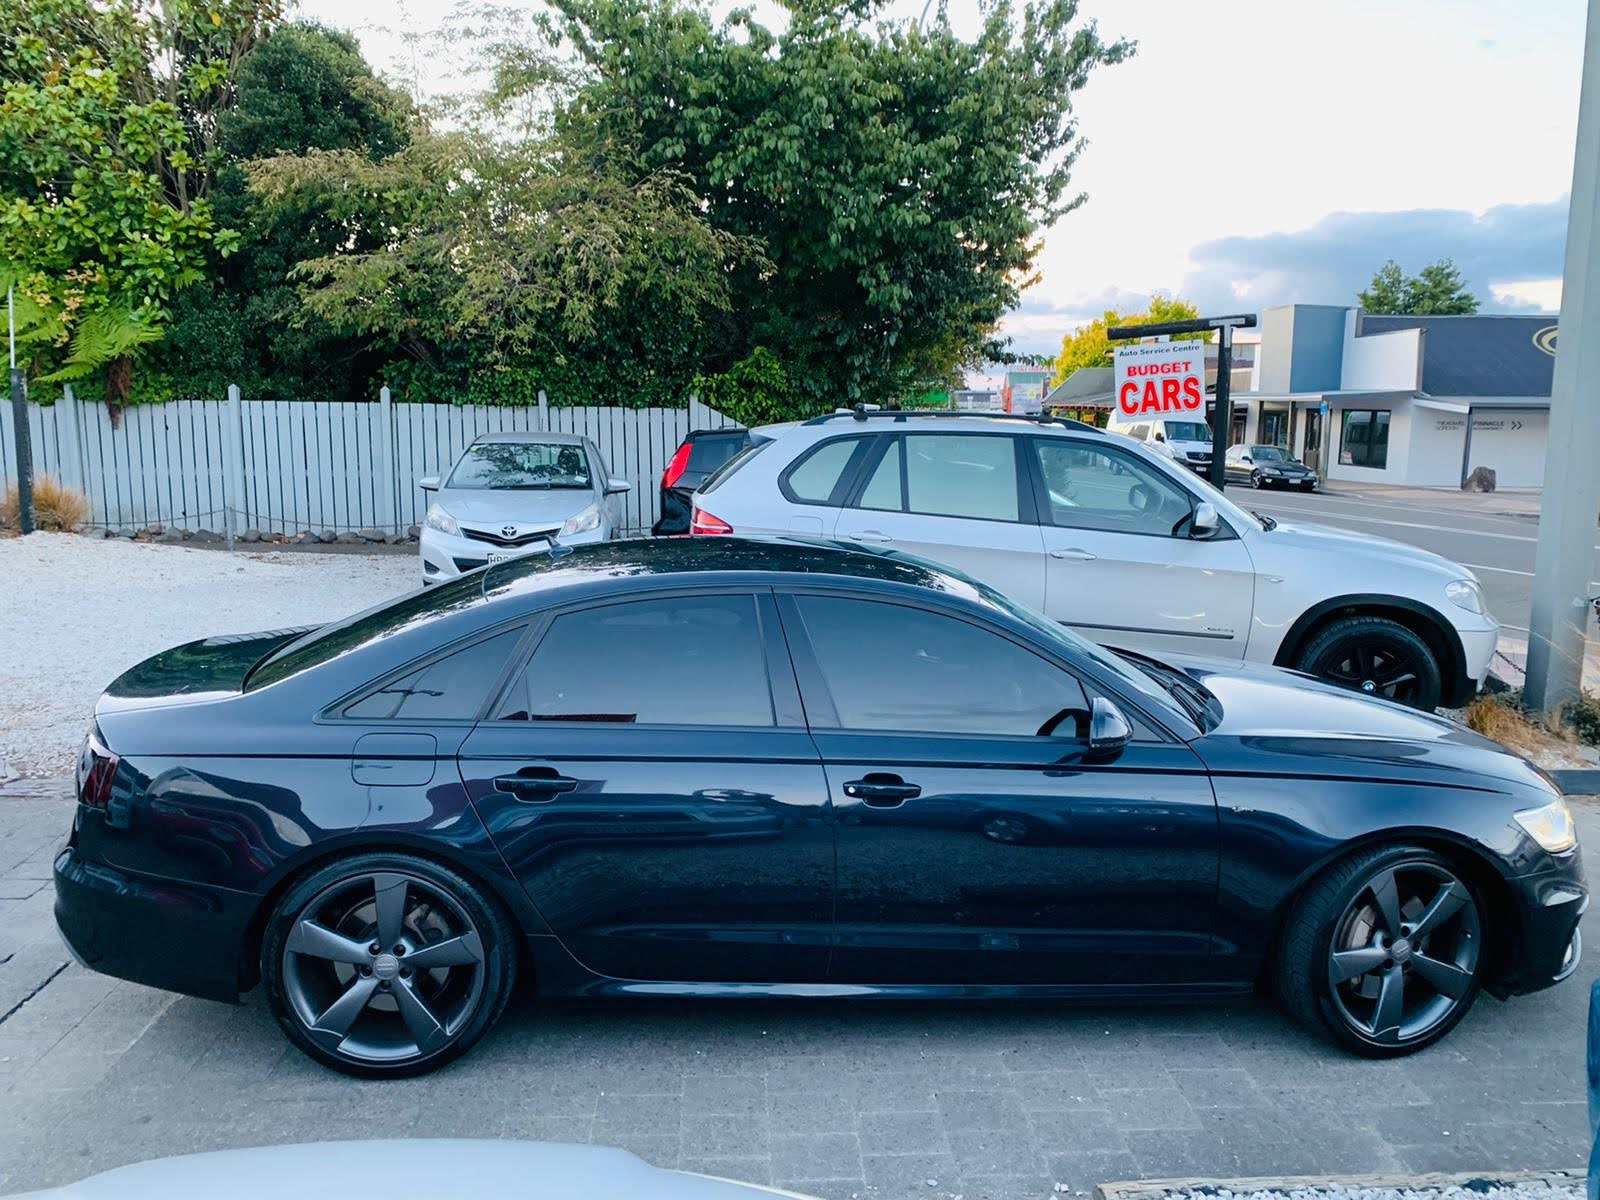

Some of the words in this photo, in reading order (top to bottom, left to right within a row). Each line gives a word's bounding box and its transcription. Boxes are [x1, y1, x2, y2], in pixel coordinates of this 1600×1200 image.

[1140, 348, 1170, 356] Service
[1127, 362, 1191, 376] BUDGET
[1120, 376, 1201, 415] CARS
